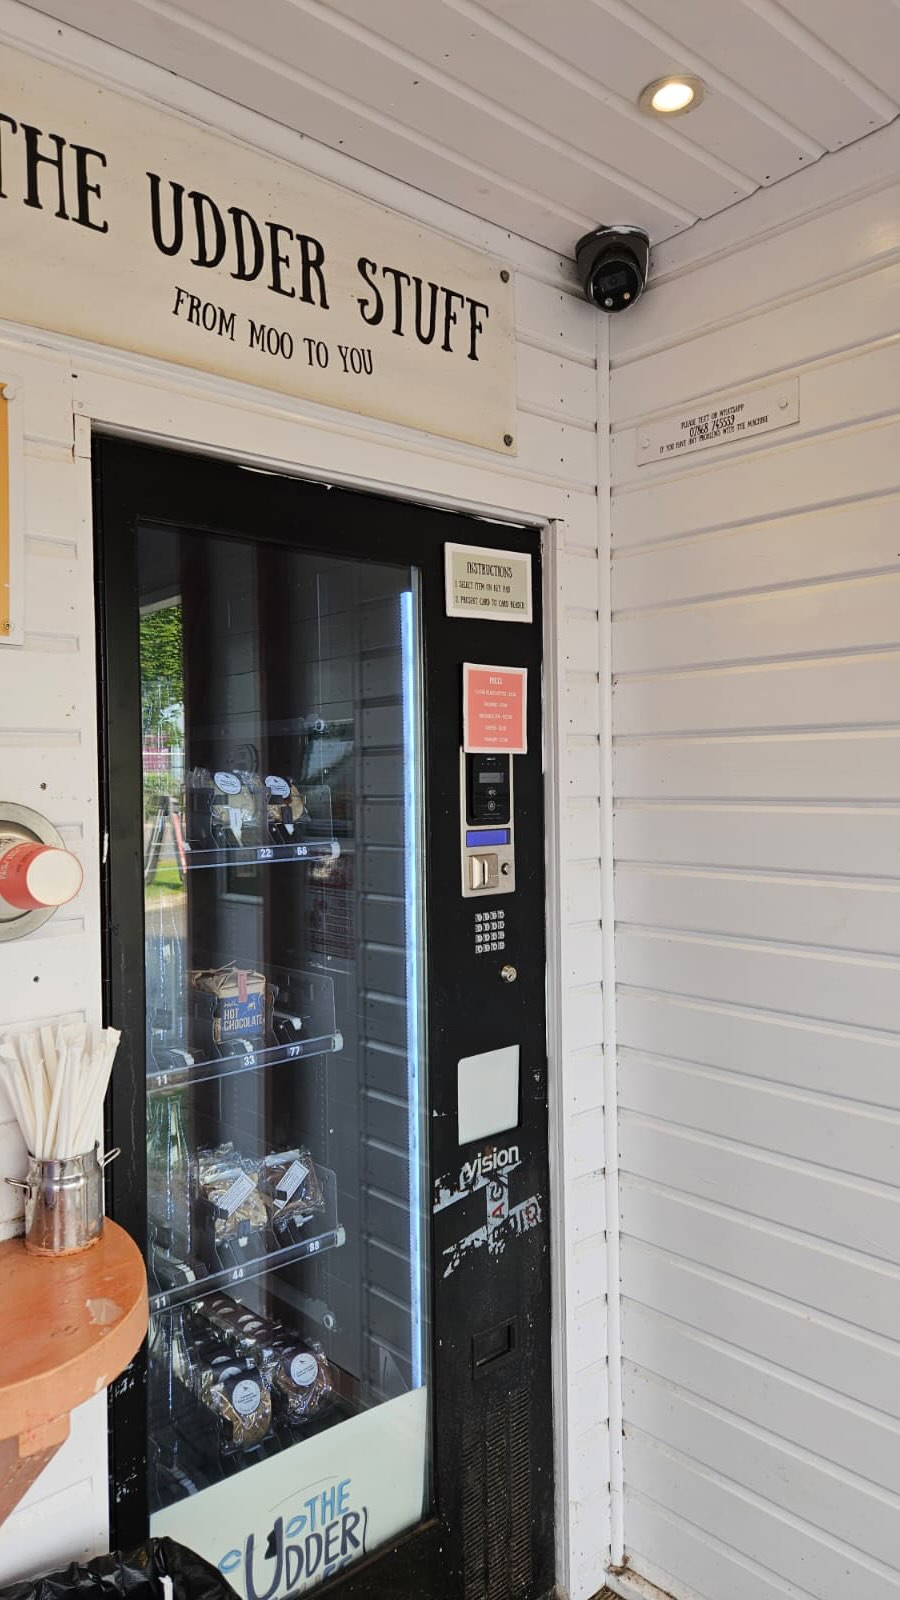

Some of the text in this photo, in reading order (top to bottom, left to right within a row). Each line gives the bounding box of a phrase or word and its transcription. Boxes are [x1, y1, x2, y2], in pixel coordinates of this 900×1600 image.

[146, 172, 330, 310] UDDER
[357, 257, 489, 361] STUFF
[172, 287, 374, 376] FROM MOO TO YOU
[466, 561, 513, 578] INSTRUCTIONS
[260, 848, 272, 858] 22
[223, 1014, 263, 1032] CHOCOLATE
[224, 1007, 239, 1021] HOT
[155, 1046, 300, 1086] 11 33 77
[154, 1296, 167, 1308] 11
[232, 1268, 244, 1280] 44
[304, 1478, 351, 1532] THE
[244, 1511, 361, 1600] UDDER
